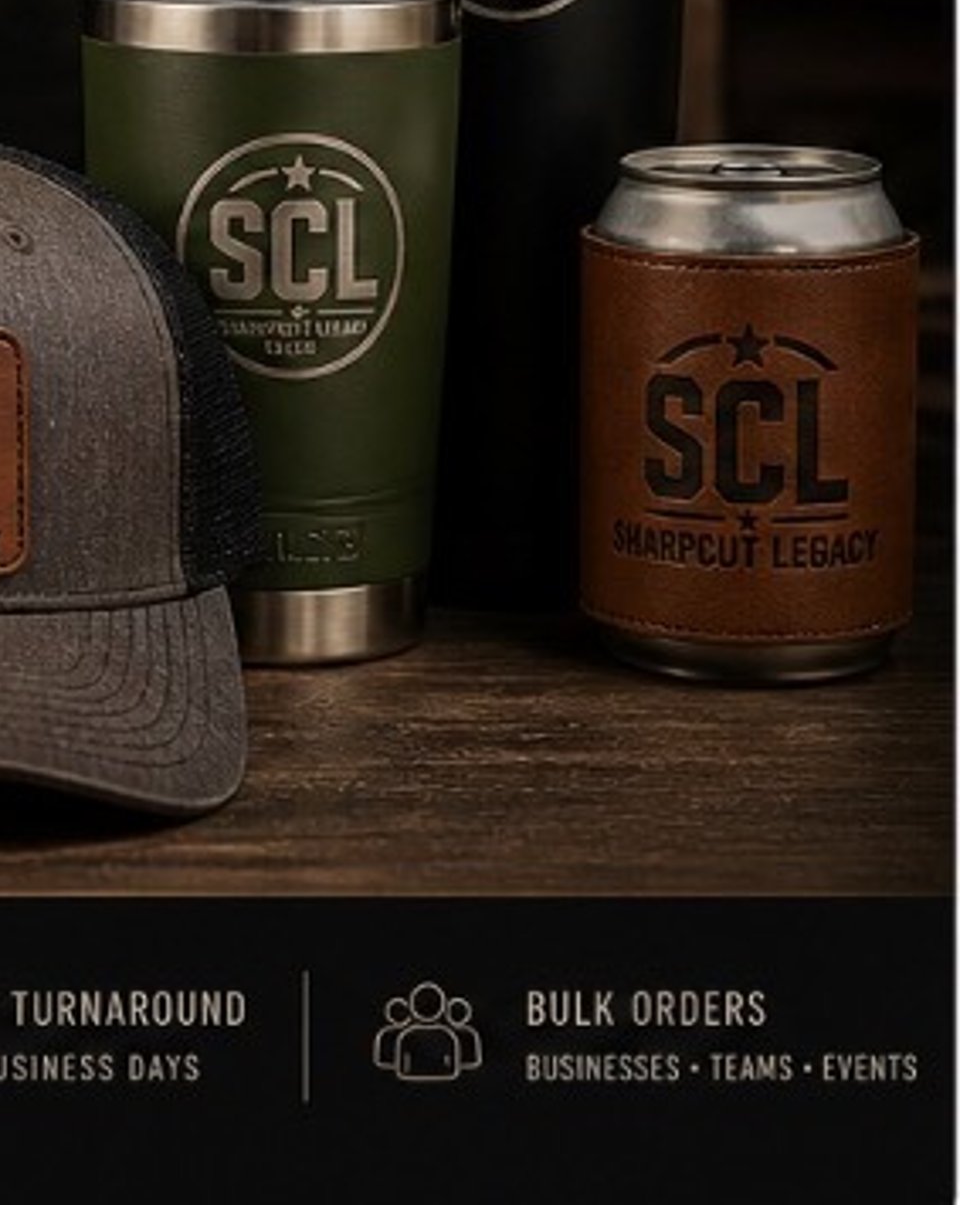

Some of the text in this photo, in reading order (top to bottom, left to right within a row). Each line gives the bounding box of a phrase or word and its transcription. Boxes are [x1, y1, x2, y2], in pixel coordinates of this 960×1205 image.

[209, 198, 379, 301] SCL
[644, 373, 849, 504] SCL
[613, 518, 879, 569] SHARPCUT LEGACY
